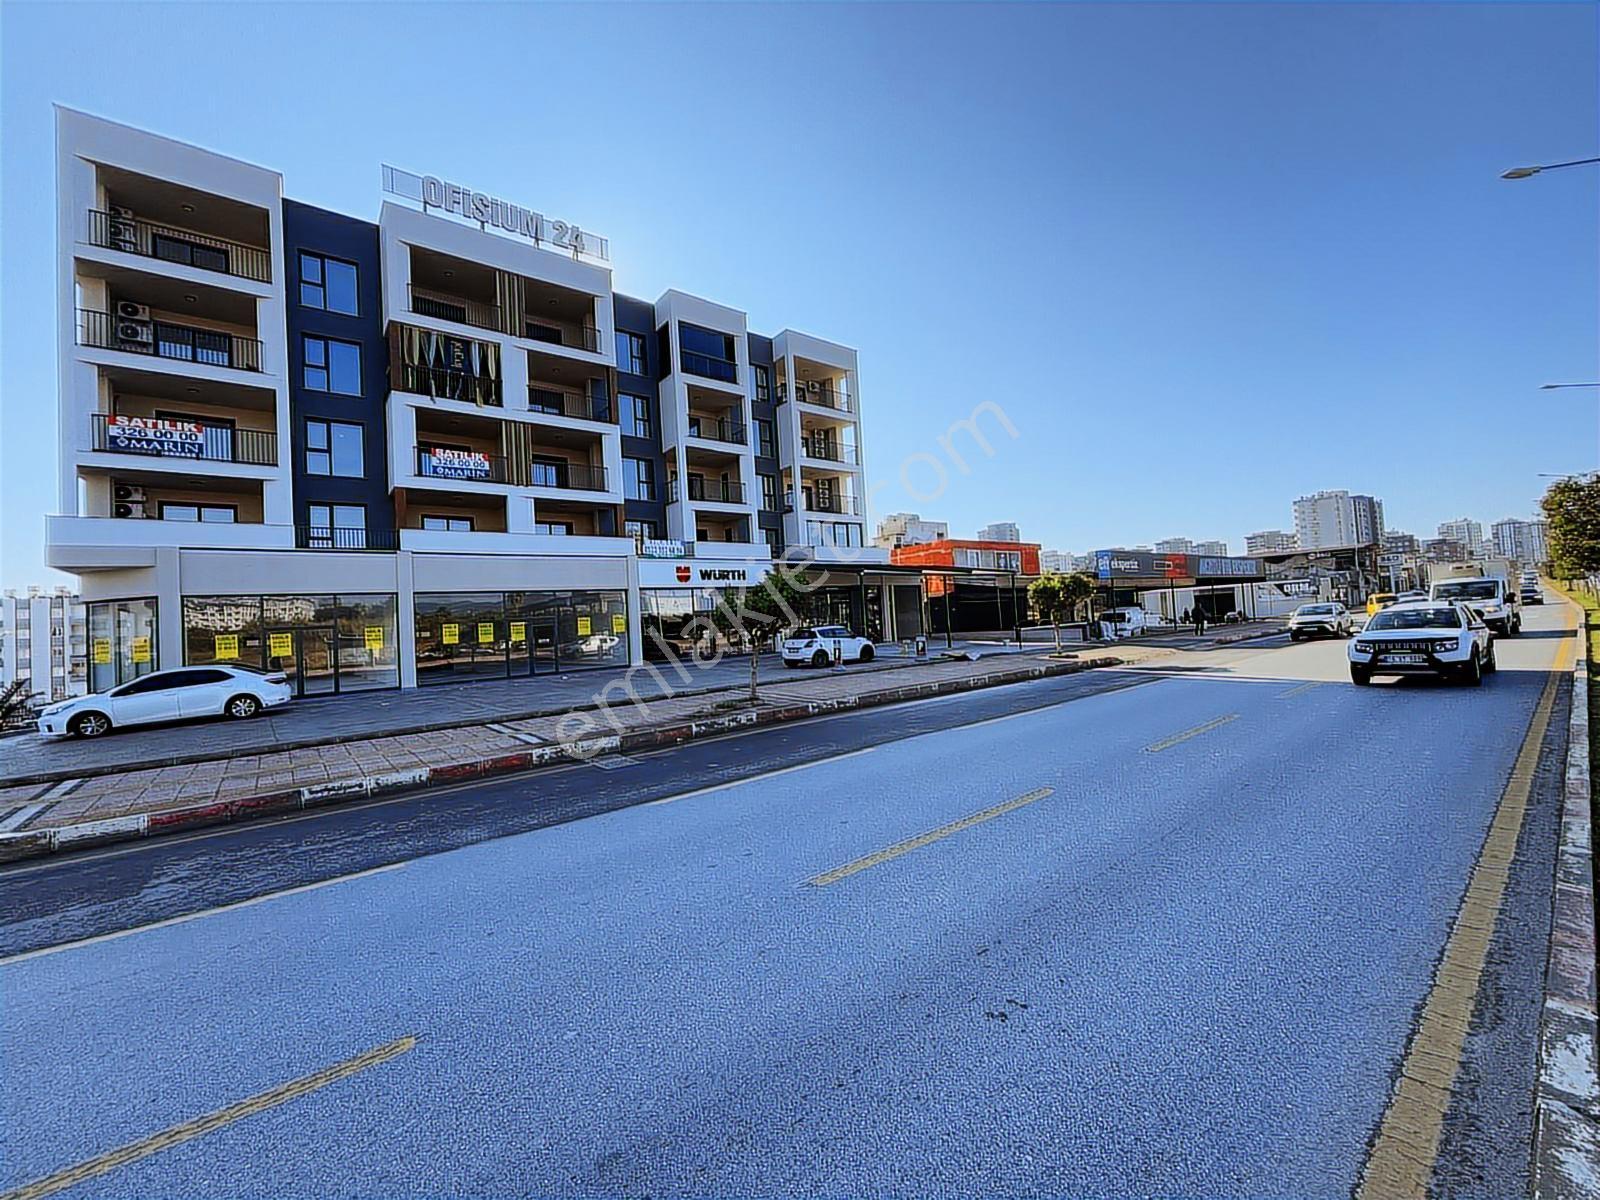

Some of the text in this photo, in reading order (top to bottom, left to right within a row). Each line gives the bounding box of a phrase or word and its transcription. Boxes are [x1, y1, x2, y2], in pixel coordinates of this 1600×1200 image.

[551, 219, 586, 254] 24
[115, 415, 199, 433] SATILIK
[116, 427, 199, 442] 326 00 00
[435, 448, 484, 461] SATILIK
